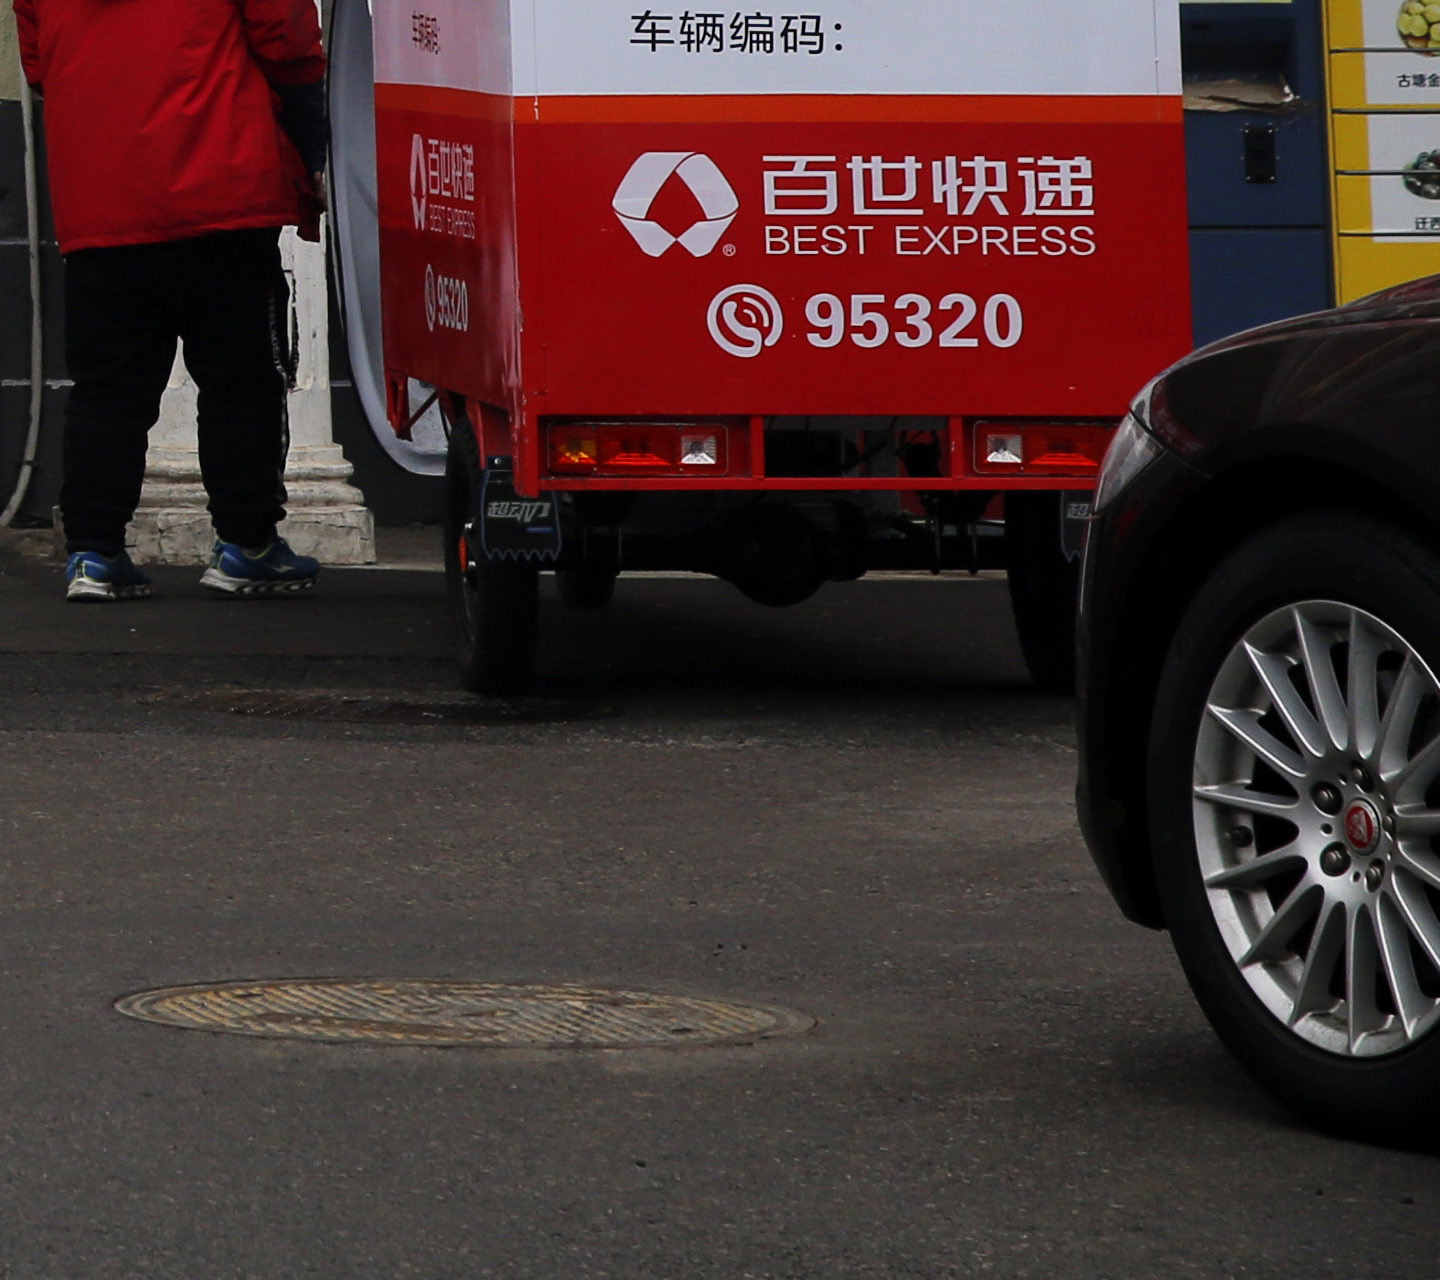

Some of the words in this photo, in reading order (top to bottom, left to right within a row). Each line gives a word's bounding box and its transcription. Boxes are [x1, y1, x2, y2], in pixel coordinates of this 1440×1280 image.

[428, 138, 475, 202] 百世快递
[762, 154, 1096, 217] 百世快递
[765, 225, 874, 256] BEST
[894, 225, 1097, 257] EXPRESS
[437, 274, 469, 332] 95320
[804, 292, 1024, 348] 95320
